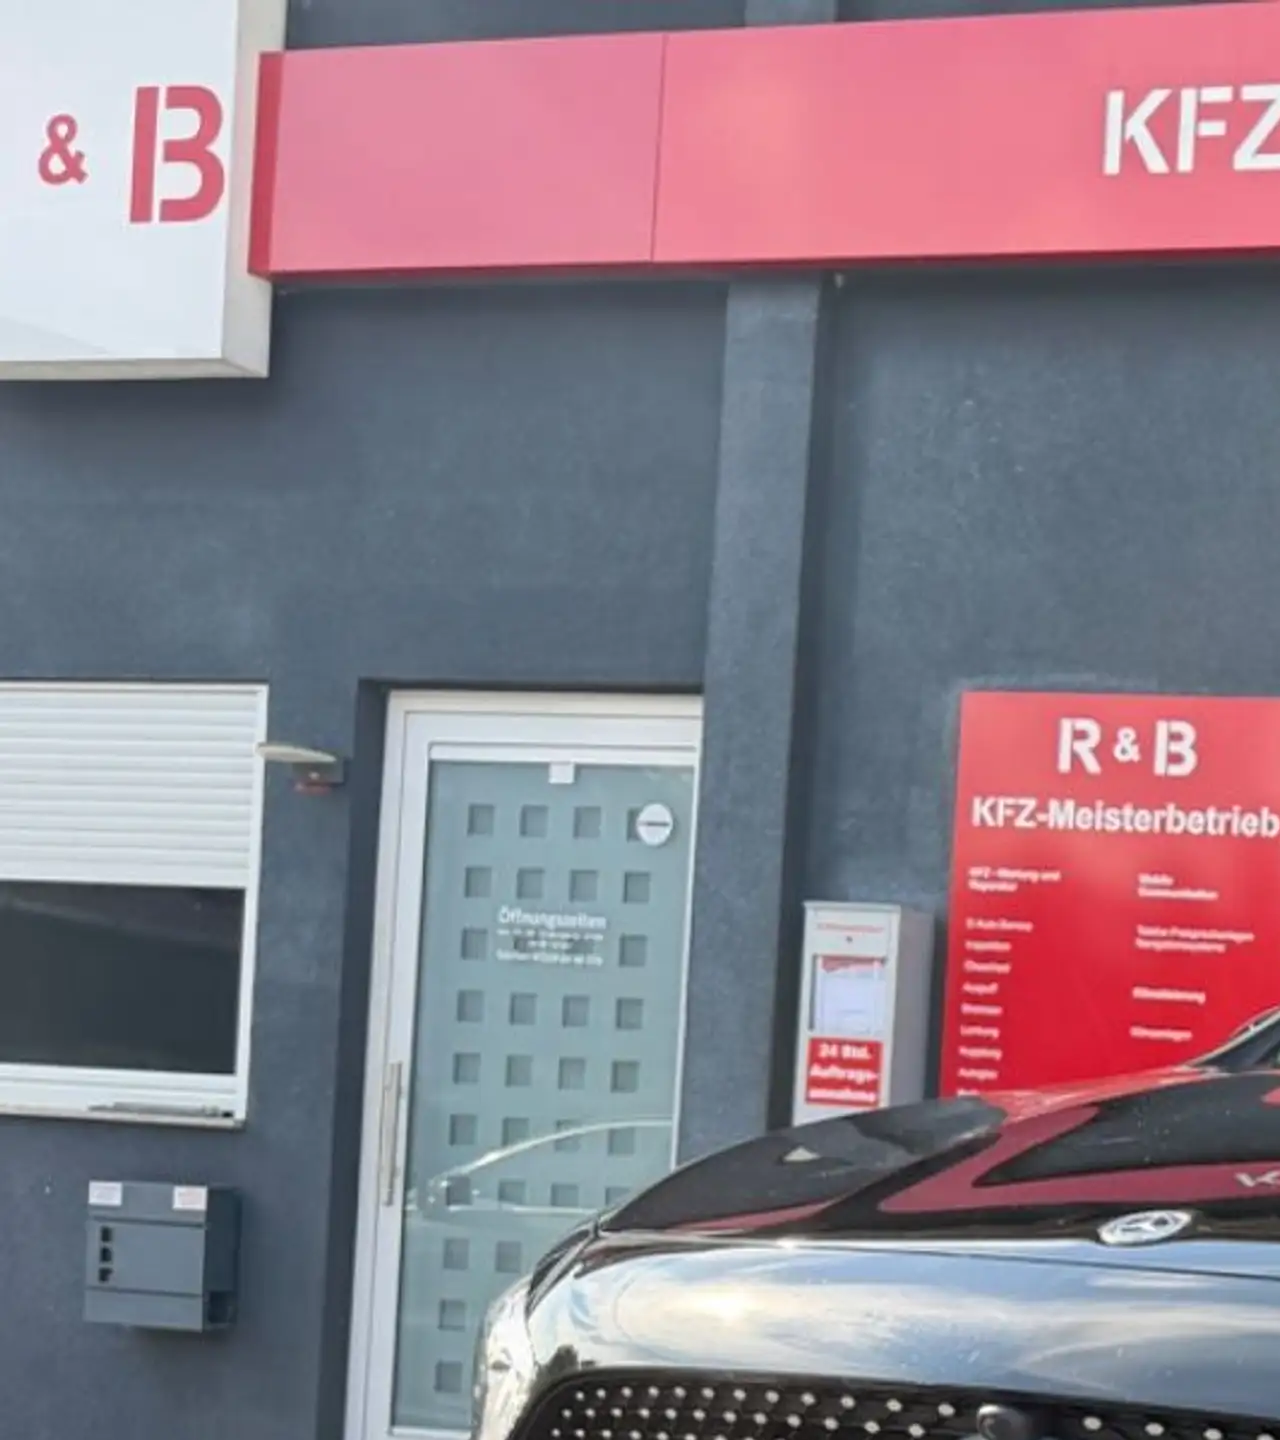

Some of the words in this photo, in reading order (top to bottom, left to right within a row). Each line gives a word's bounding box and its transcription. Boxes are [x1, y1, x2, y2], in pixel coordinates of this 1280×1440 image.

[38, 114, 89, 185] &
[130, 85, 225, 223] B
[1057, 717, 1101, 774] R
[1113, 726, 1141, 763] &
[1153, 720, 1198, 776] B
